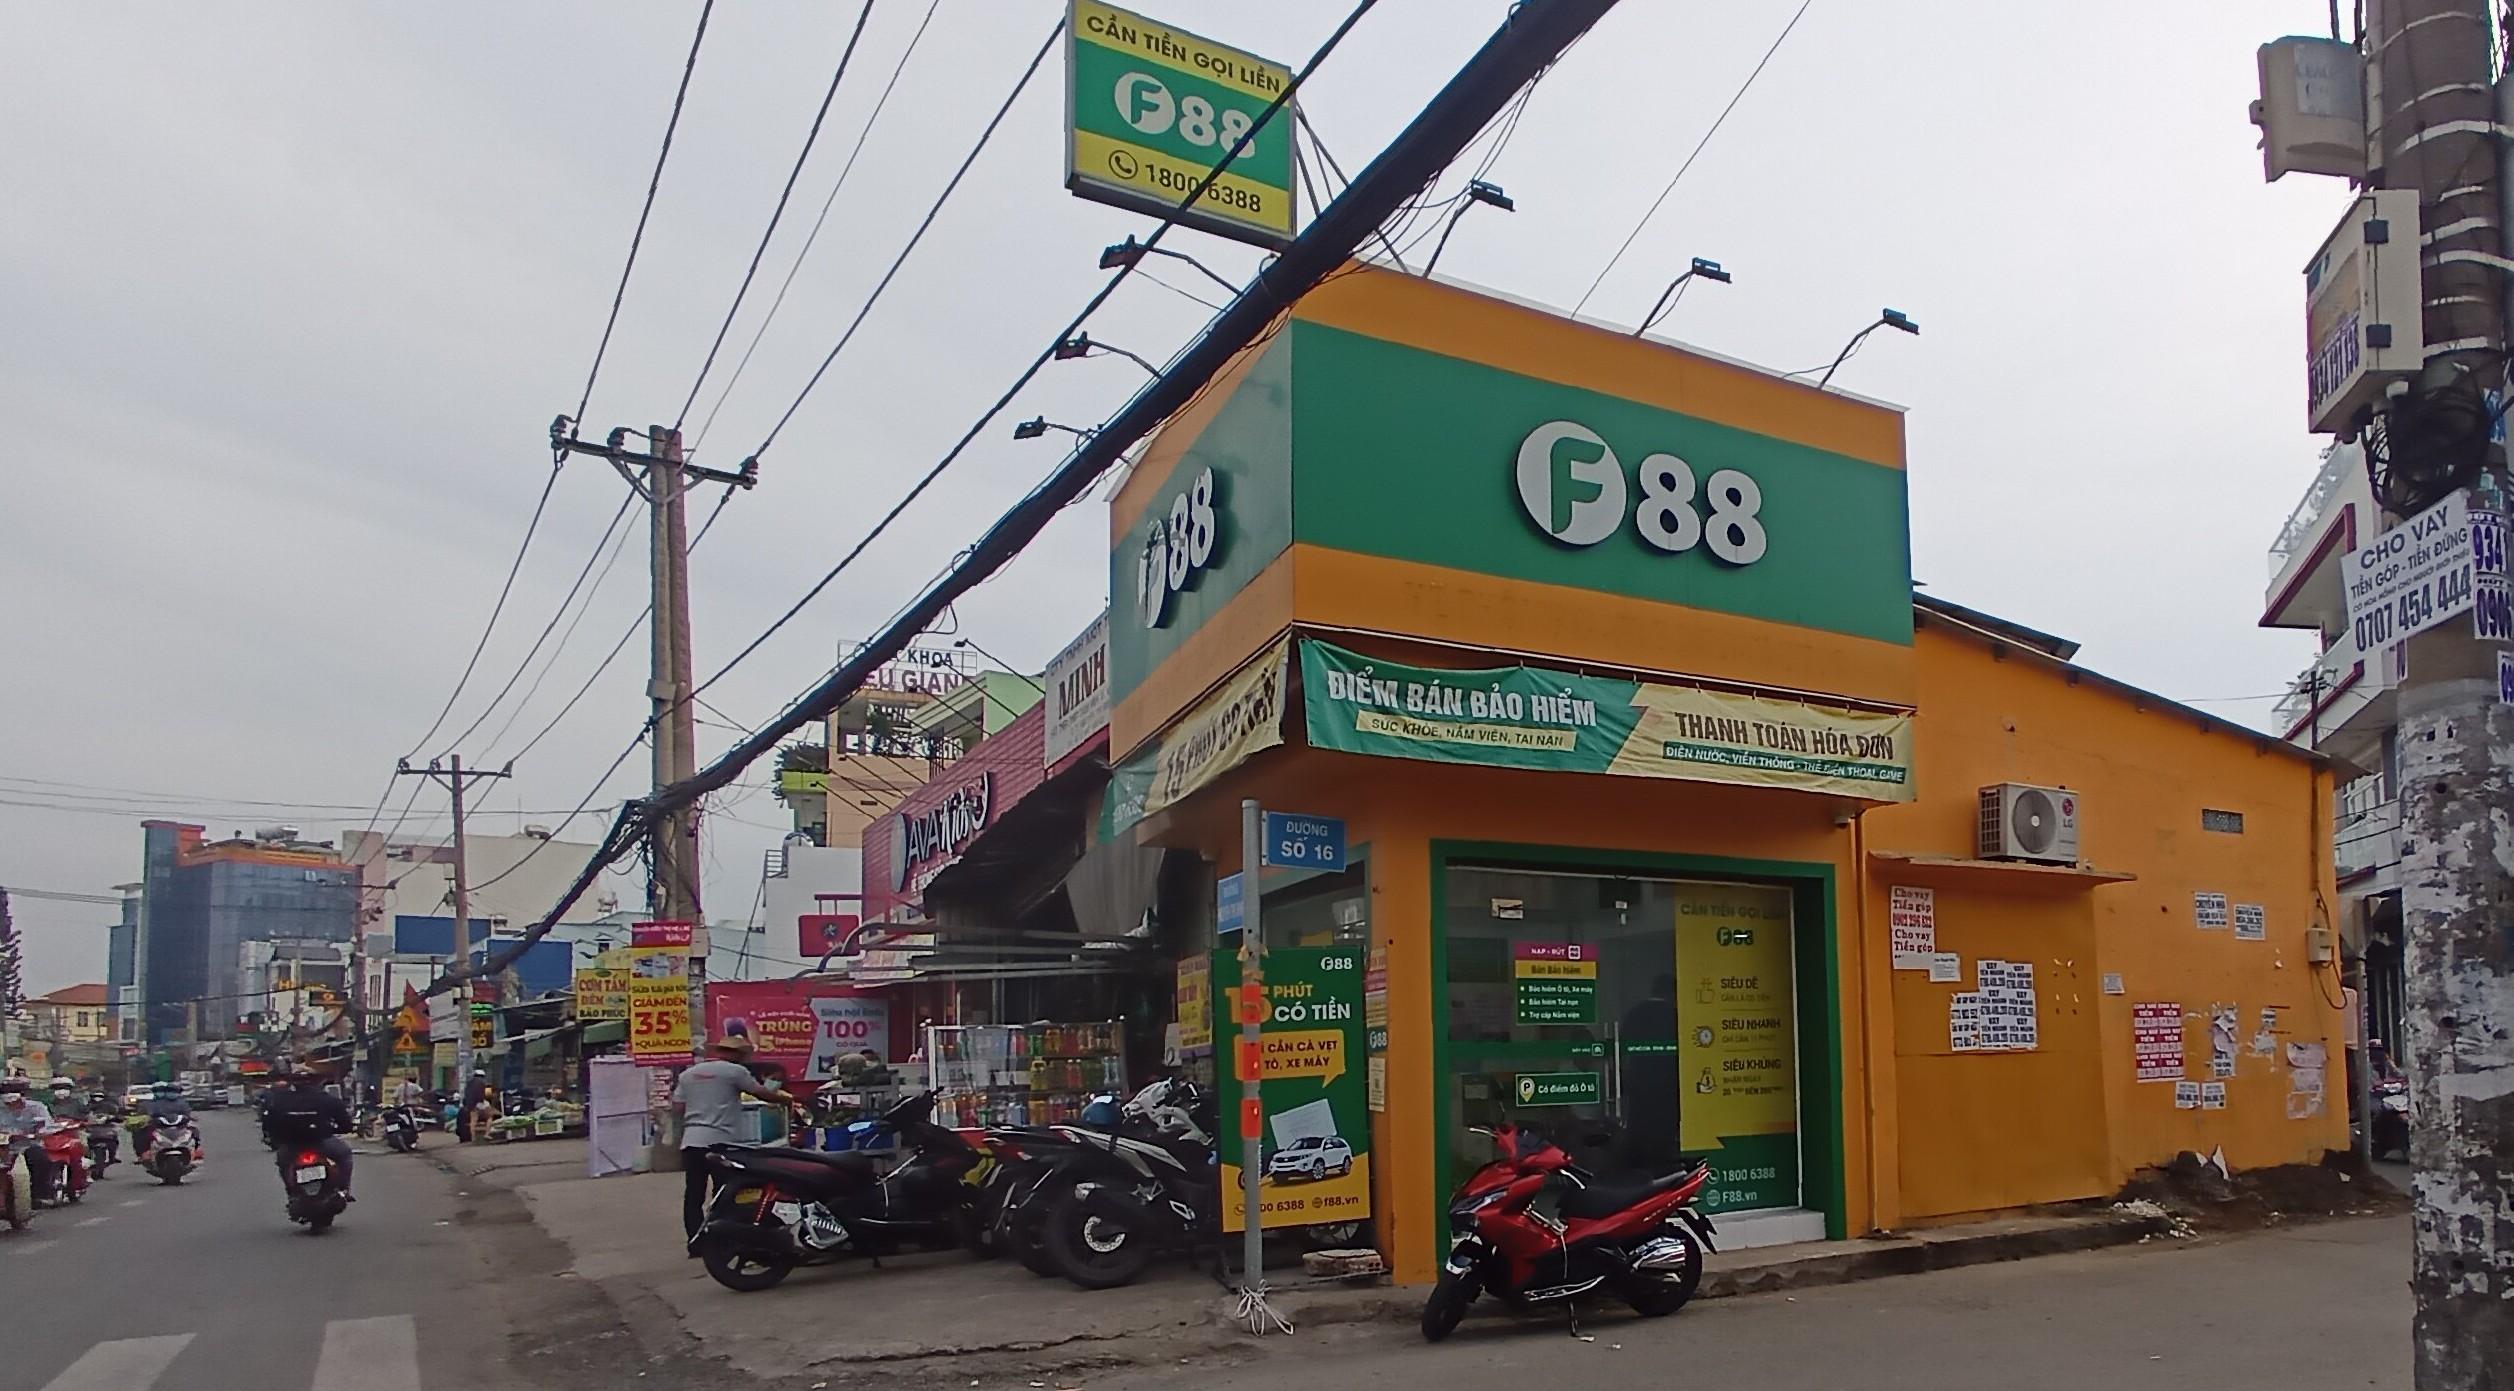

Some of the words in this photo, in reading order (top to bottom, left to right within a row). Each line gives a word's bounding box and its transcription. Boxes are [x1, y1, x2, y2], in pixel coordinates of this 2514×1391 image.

[1087, 14, 1136, 44] CẦN
[1143, 32, 1186, 62] TIỀN
[1194, 52, 1233, 78] GỌI
[1240, 65, 1280, 93] LIỀN
[1114, 71, 1256, 158] F88
[1145, 164, 1199, 194] 1800
[1207, 183, 1261, 212] 6388
[1516, 420, 1767, 564] F88
[2361, 533, 2405, 569] CHO
[2411, 506, 2447, 541] VAY
[2351, 575, 2372, 599] TIỀN
[2375, 562, 2399, 586] GÓP
[2408, 544, 2430, 569] TIỀN
[2435, 527, 2467, 557] ĐỨNG
[2355, 602, 2393, 652] 0707
[2399, 583, 2432, 630] 454
[2438, 563, 2472, 611] 444
[1058, 644, 1105, 719] MINH
[1328, 666, 1398, 709] ĐIỂM
[1407, 679, 1463, 717] BÁN
[1470, 683, 1523, 720] BẢO
[1531, 688, 1596, 727] HIỂM
[1372, 718, 1398, 732] SỨC
[1446, 725, 1474, 740] NẰM
[1514, 733, 1533, 744] TAI
[1537, 735, 1563, 748] NẠN
[1674, 712, 1749, 745] THANH
[1752, 721, 1807, 753] TOÁN
[1811, 727, 1851, 756] HÓA
[1856, 732, 1894, 760] ĐƠN
[1286, 817, 1328, 837] ĐƯỜNG
[2063, 819, 2074, 828] LG
[1281, 836, 1306, 858] SỐ
[1314, 845, 1334, 861] 16
[1894, 888, 1912, 898] Cho
[1914, 891, 1930, 901] vay
[1894, 928, 1913, 939] Cho
[1915, 932, 1931, 942] vay
[1321, 957, 1353, 970] F88
[1273, 981, 1313, 998] PHÚT
[1721, 976, 1743, 990] SIÊU
[633, 997, 664, 1008] GIẢM
[1274, 1001, 1307, 1021] CÓ
[1311, 996, 1351, 1020] TIỀN
[635, 1010, 688, 1035] 35%
[756, 1017, 812, 1032] TRÚNG
[1722, 1017, 1744, 1031] SIÊU
[1747, 1018, 1780, 1030] NHANH
[759, 1034, 776, 1053] 5
[1268, 1039, 1293, 1053] CẦN
[1297, 1039, 1314, 1052] CÀ
[1318, 1040, 1338, 1054] VẸT
[1287, 1058, 1300, 1068] XE
[1304, 1056, 1330, 1067] MÁY
[1723, 1058, 1744, 1072] SIÊU
[1747, 1056, 1781, 1070] KHỦNG
[1523, 1082, 1531, 1092] P
[1538, 1084, 1549, 1094] Có
[1550, 1083, 1568, 1094] điểm
[1722, 1169, 1747, 1182] 1800
[1750, 1167, 1775, 1180] 6388
[1723, 1190, 1757, 1203] F88.vn
[1260, 1203, 1273, 1213] 00
[1277, 1200, 1305, 1212] 6388
